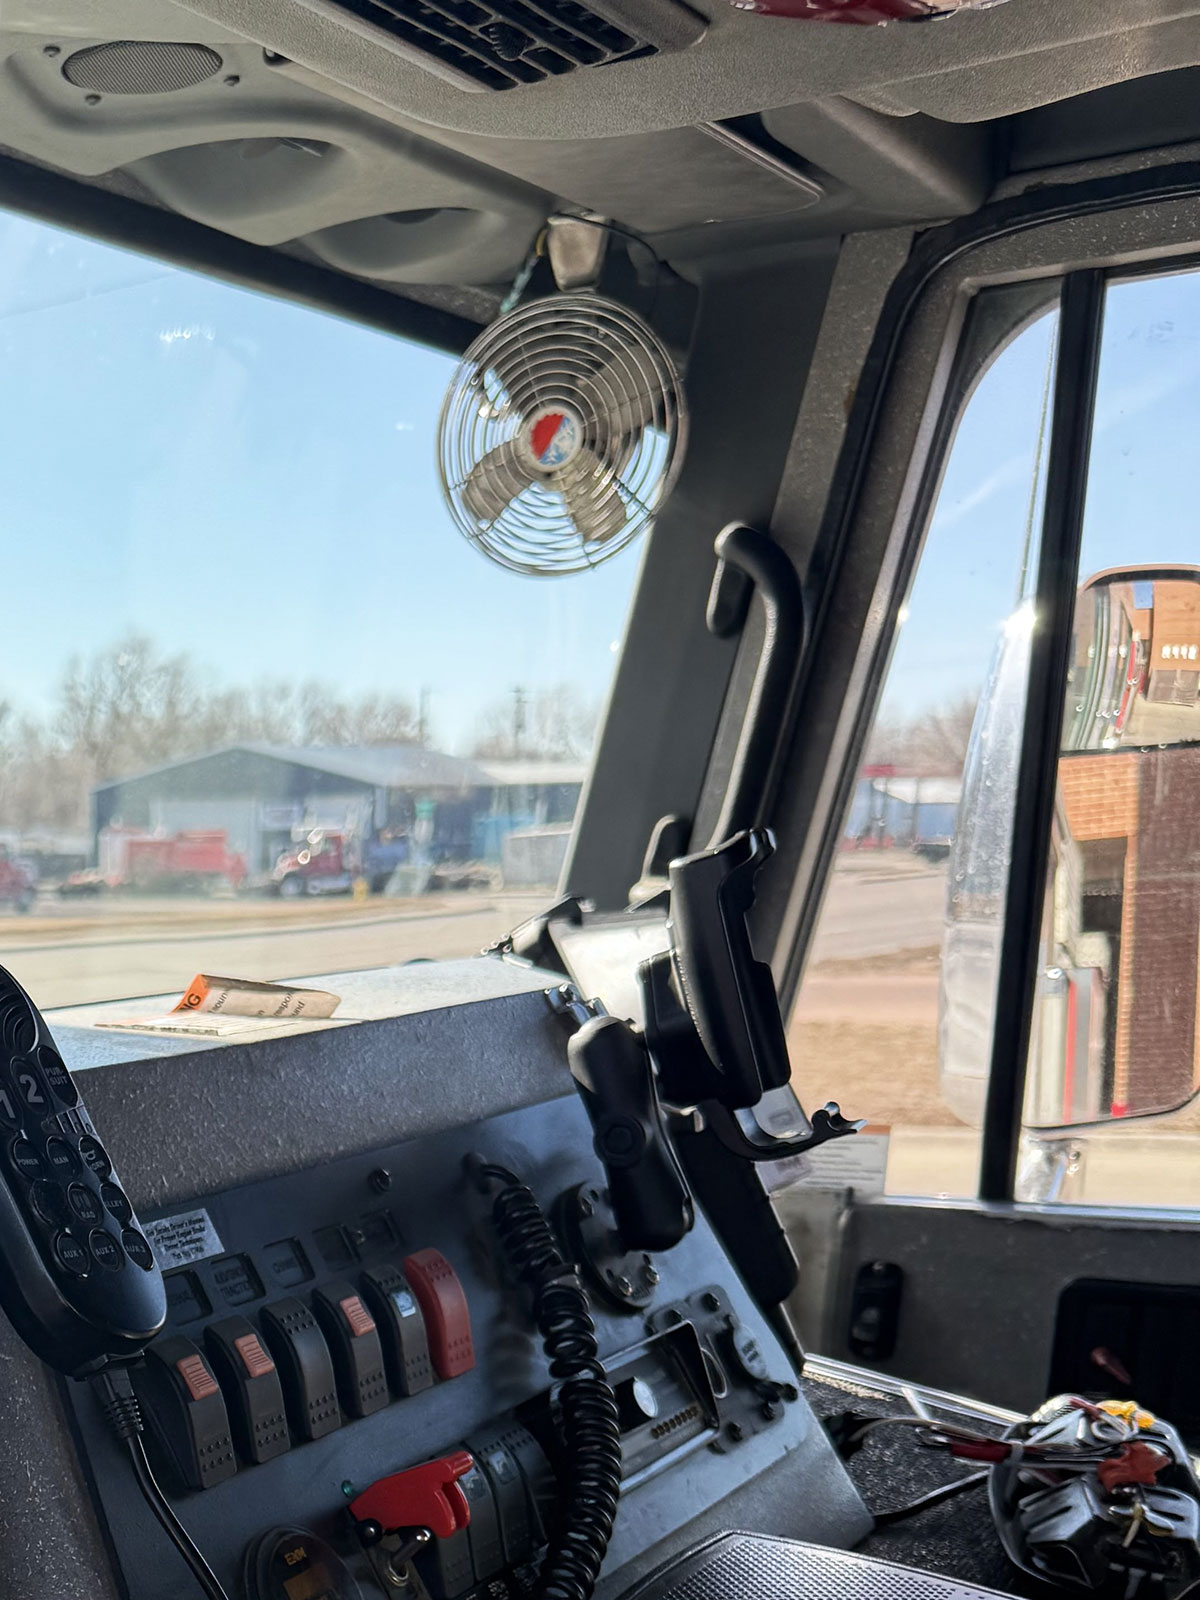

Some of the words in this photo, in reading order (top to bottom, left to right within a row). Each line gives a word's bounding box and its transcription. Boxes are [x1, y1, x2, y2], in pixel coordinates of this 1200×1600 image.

[19, 1074, 44, 1103] 2
[63, 1250, 78, 1259] AUX
[95, 1247, 109, 1256] AUX
